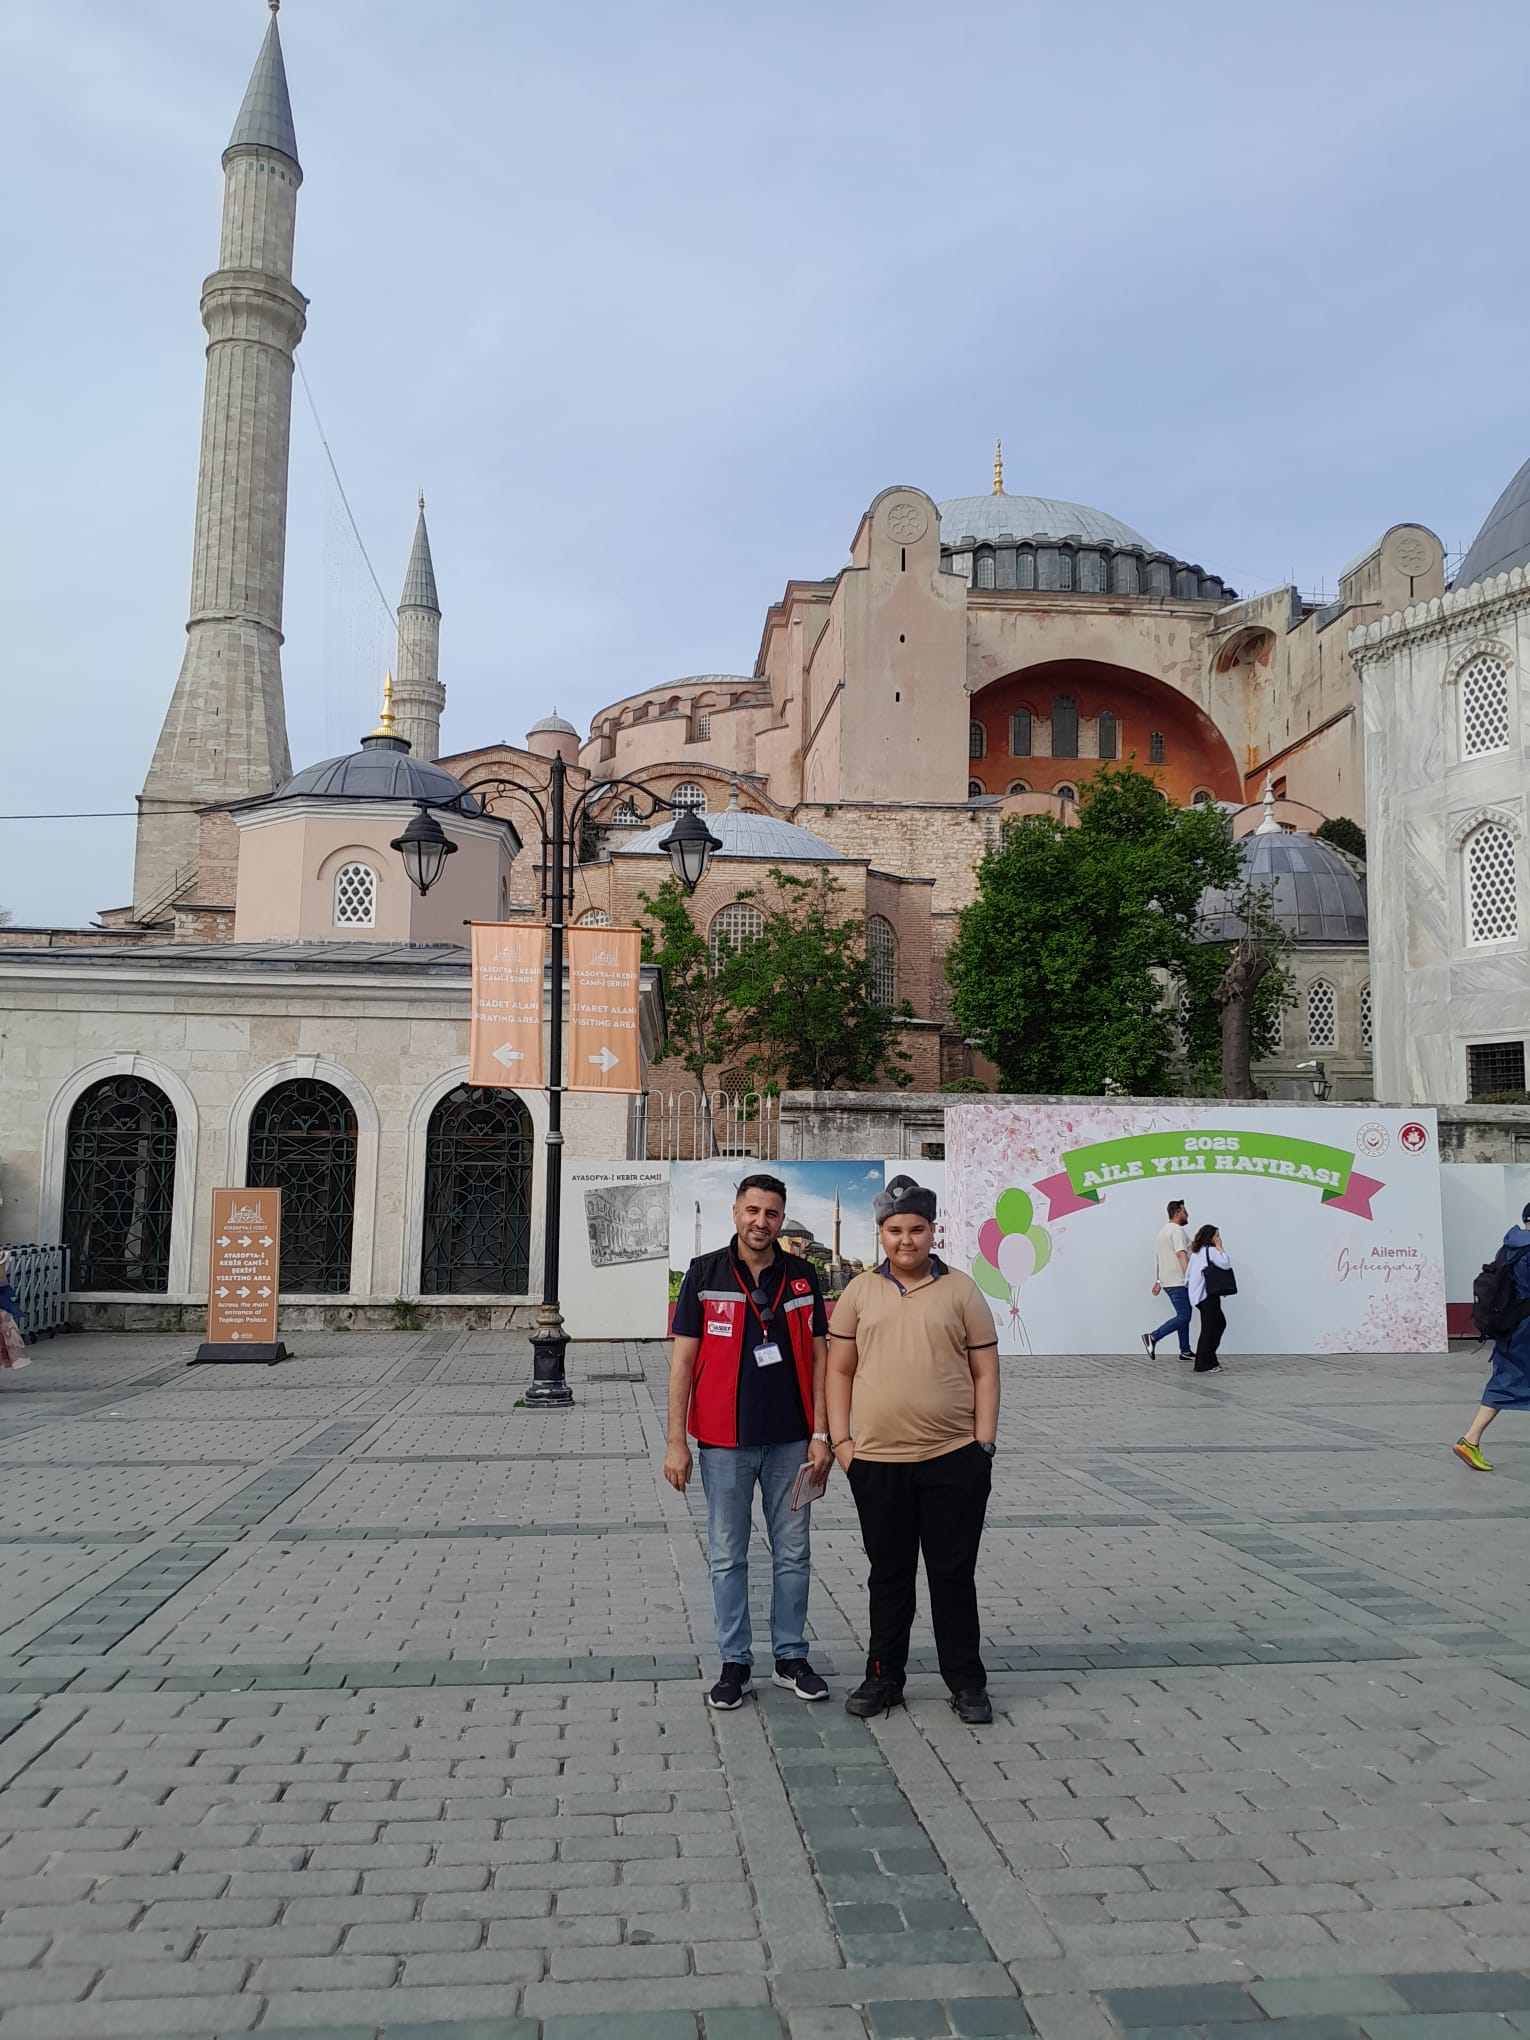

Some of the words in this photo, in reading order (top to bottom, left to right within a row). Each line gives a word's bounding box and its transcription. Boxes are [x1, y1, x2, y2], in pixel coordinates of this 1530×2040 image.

[512, 1001, 539, 1010] ALANI
[611, 1007, 637, 1015] ALANI
[475, 1013, 514, 1023] PRAYING
[516, 1016, 539, 1024] AREA
[613, 1021, 636, 1029] AREA
[1184, 1136, 1241, 1151] 2025
[1082, 1160, 1145, 1188] AİLE
[1150, 1155, 1207, 1173] YILI
[1214, 1155, 1342, 1188] HATIRASI
[571, 1173, 615, 1181] AYASOFYA-İ
[616, 1173, 638, 1181] KEBİR
[1370, 1246, 1418, 1258] Ailemiz
